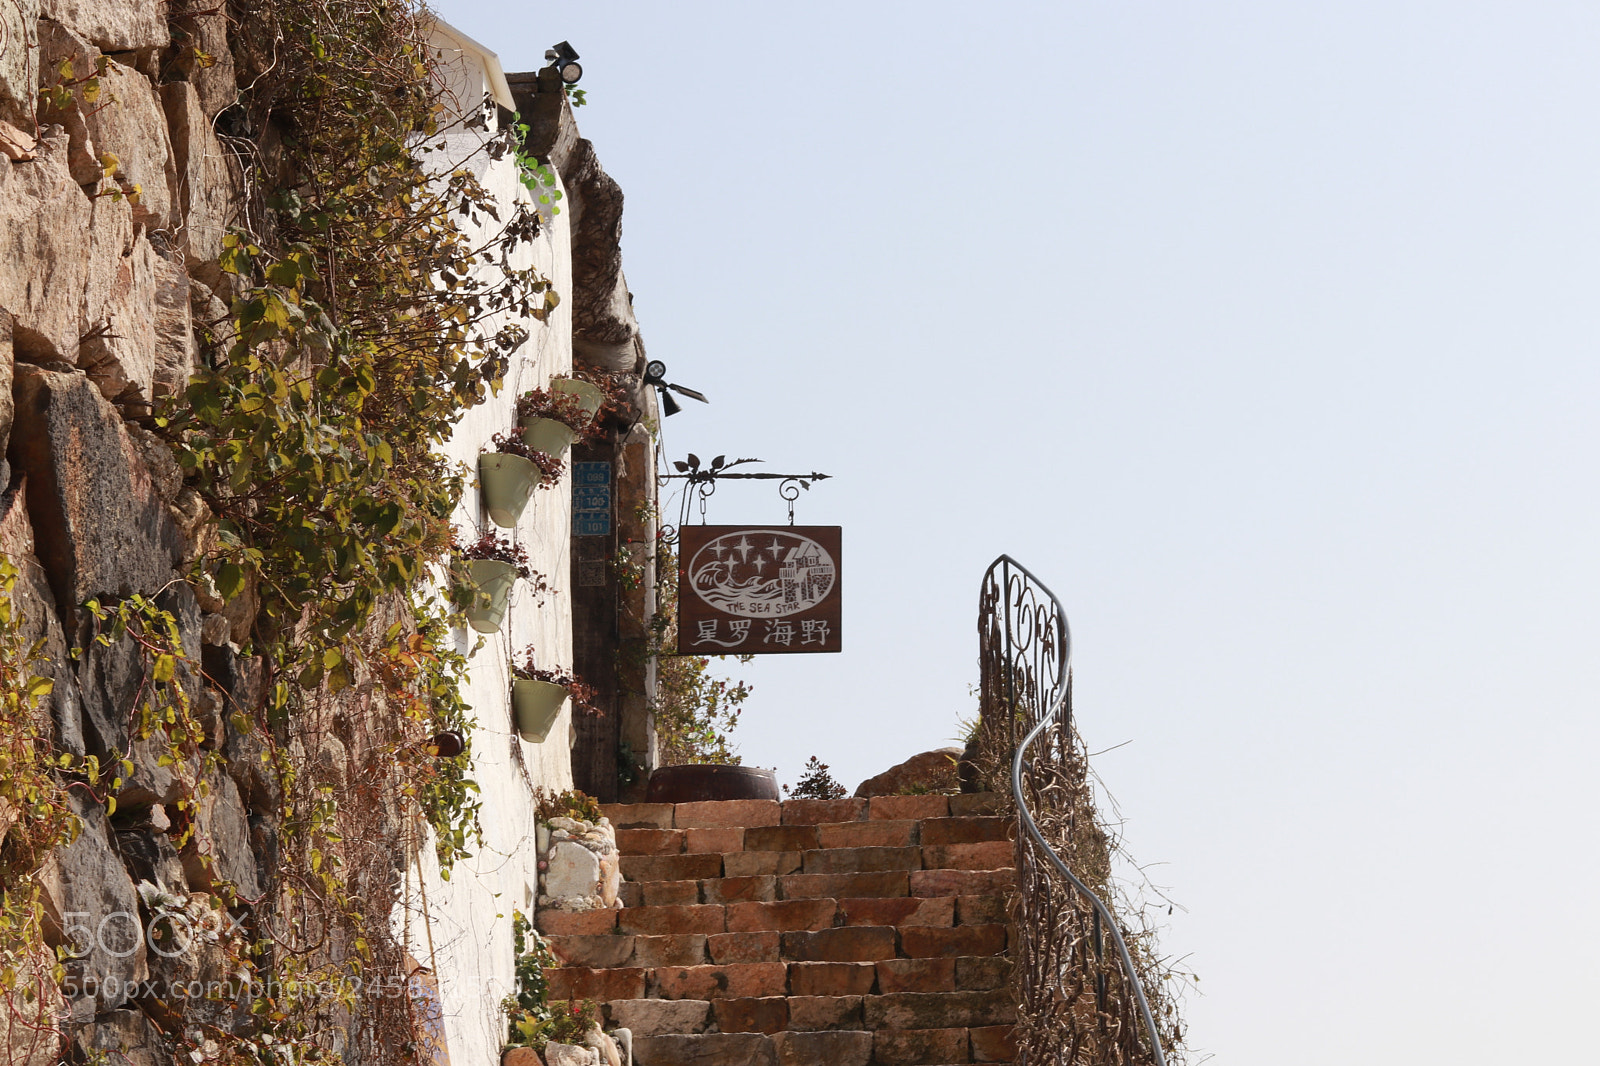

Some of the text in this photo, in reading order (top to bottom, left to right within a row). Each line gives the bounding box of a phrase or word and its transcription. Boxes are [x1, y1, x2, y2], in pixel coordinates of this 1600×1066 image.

[726, 601, 801, 613] THE SEA STAR
[690, 618, 831, 648] 星罗海野
